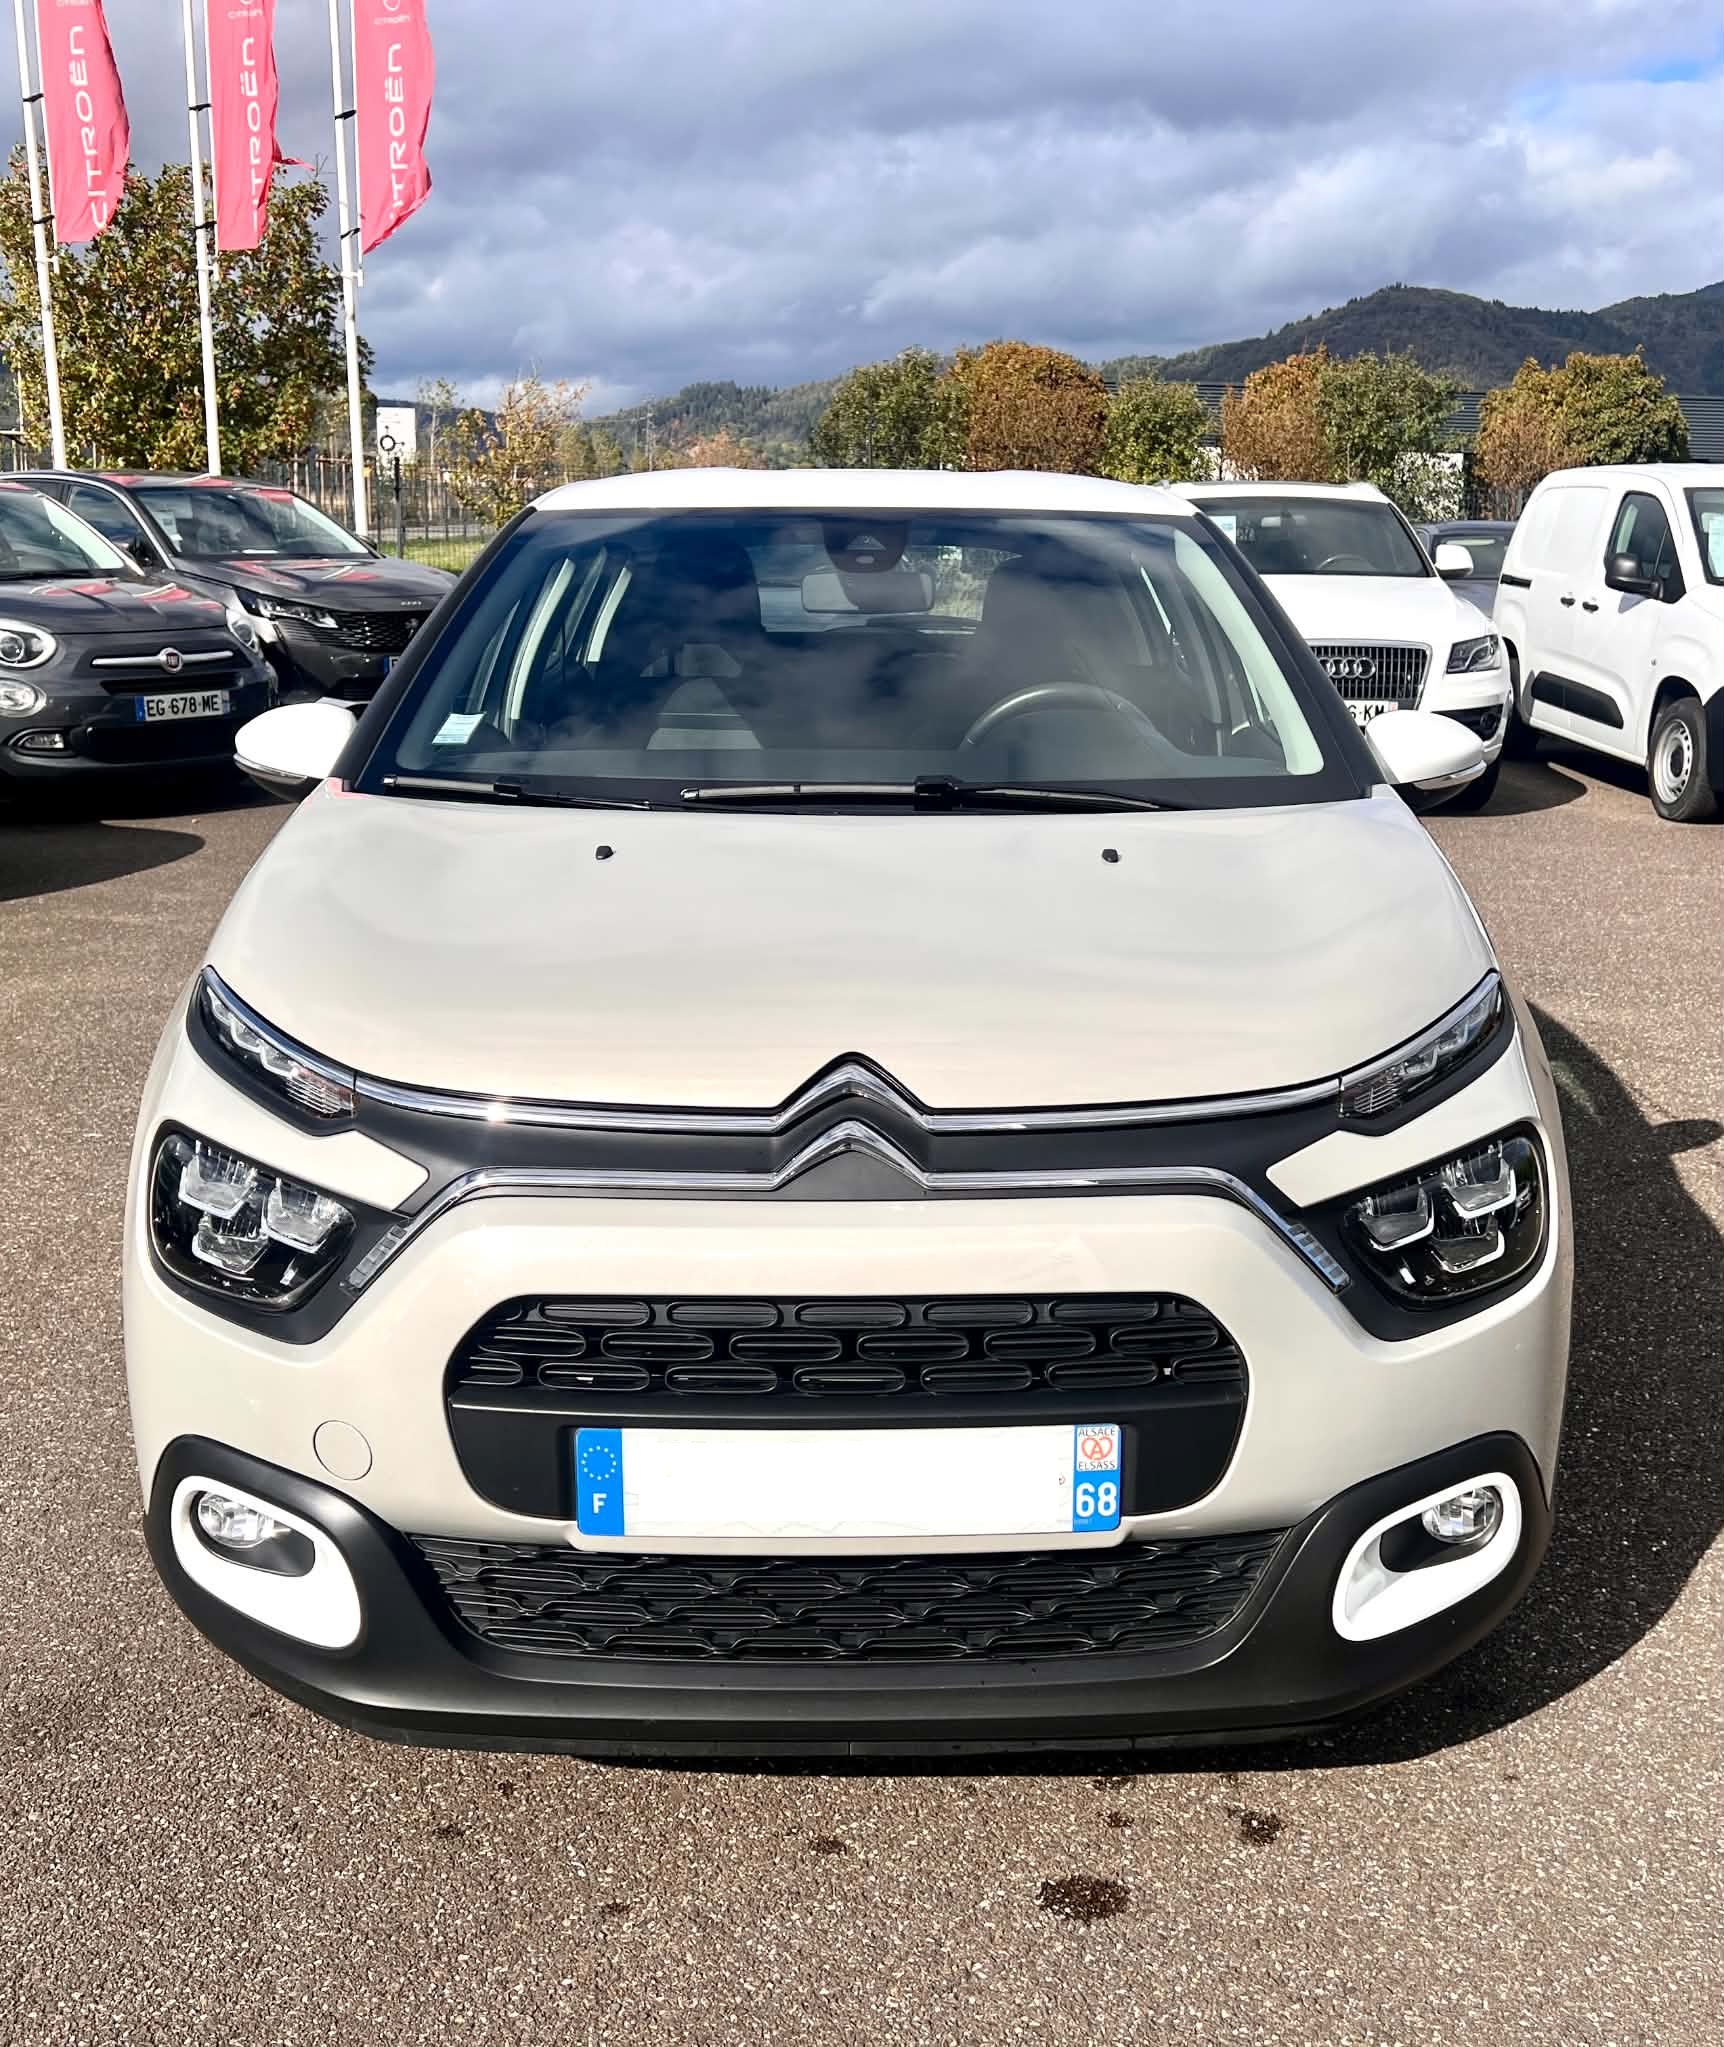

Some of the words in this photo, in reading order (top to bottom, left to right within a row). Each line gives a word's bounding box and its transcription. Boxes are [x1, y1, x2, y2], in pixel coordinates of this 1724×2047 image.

[1078, 1427, 1116, 1437] ALSACE
[1078, 1460, 1116, 1471] ELSASS
[592, 1492, 608, 1515] F
[1076, 1481, 1117, 1518] 68
